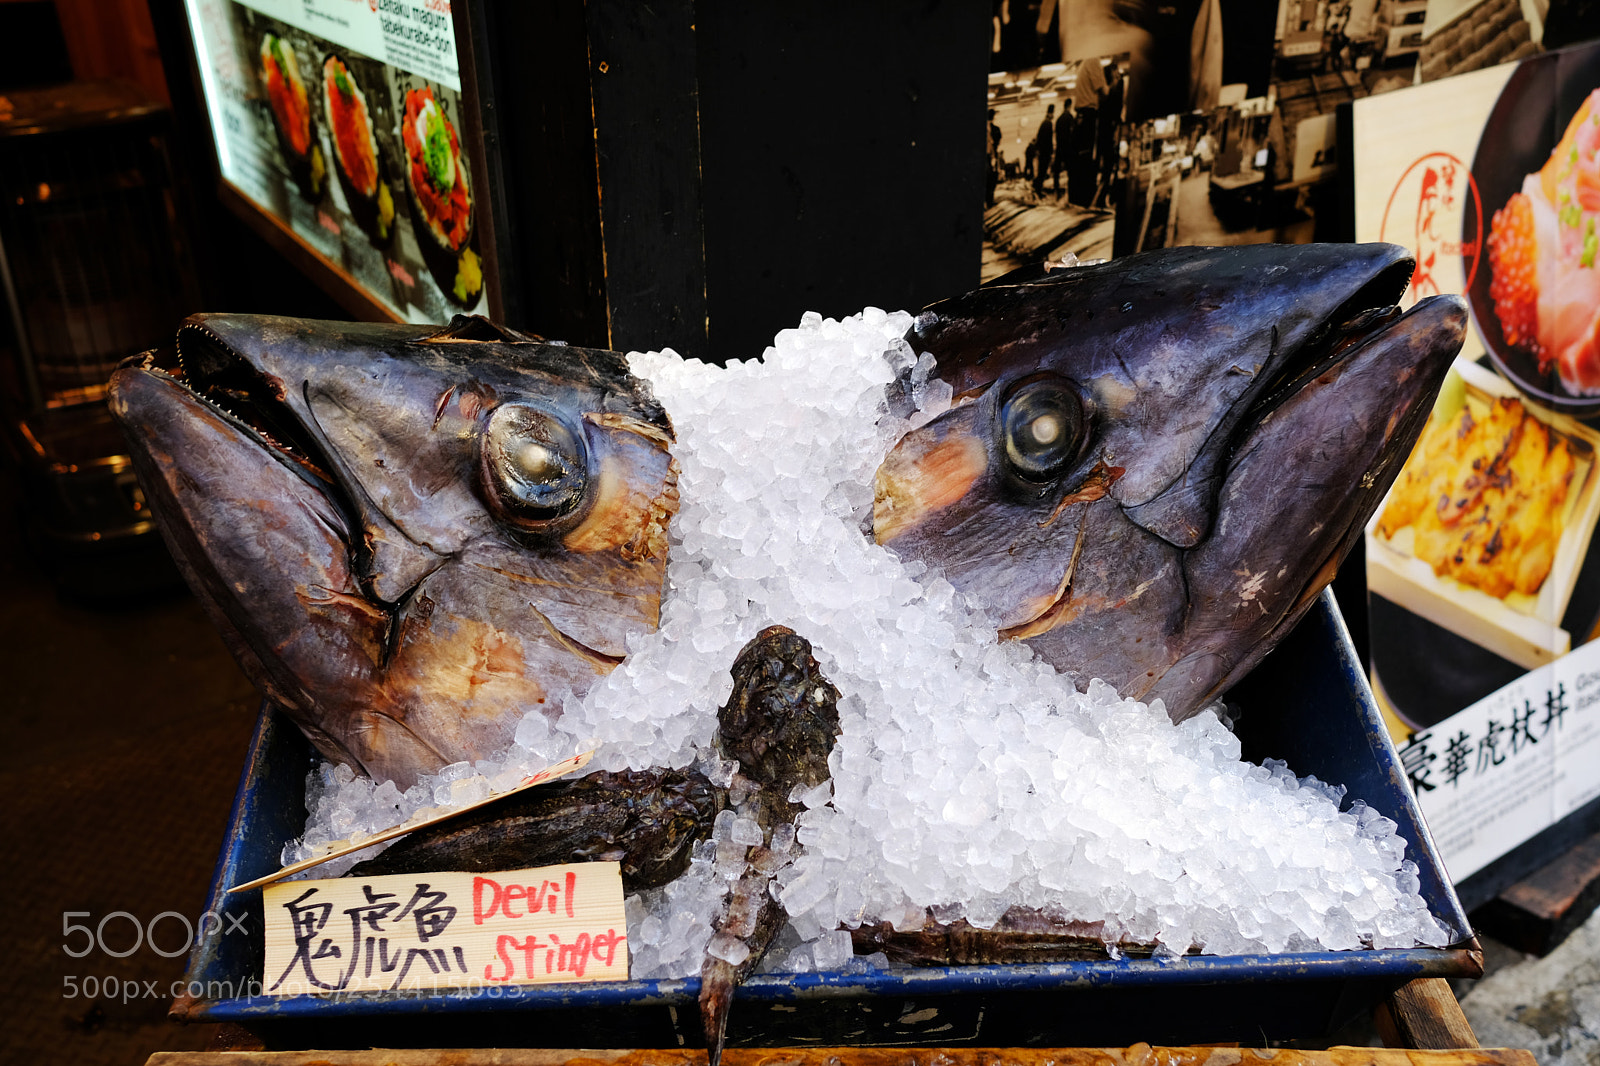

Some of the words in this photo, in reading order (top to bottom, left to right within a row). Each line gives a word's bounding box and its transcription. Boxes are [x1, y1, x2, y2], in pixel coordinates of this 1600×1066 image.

[412, 7, 448, 31] maguro
[473, 872, 576, 926] Devil
[268, 884, 467, 990] 鬼虎魚
[484, 928, 627, 982] Stinger
